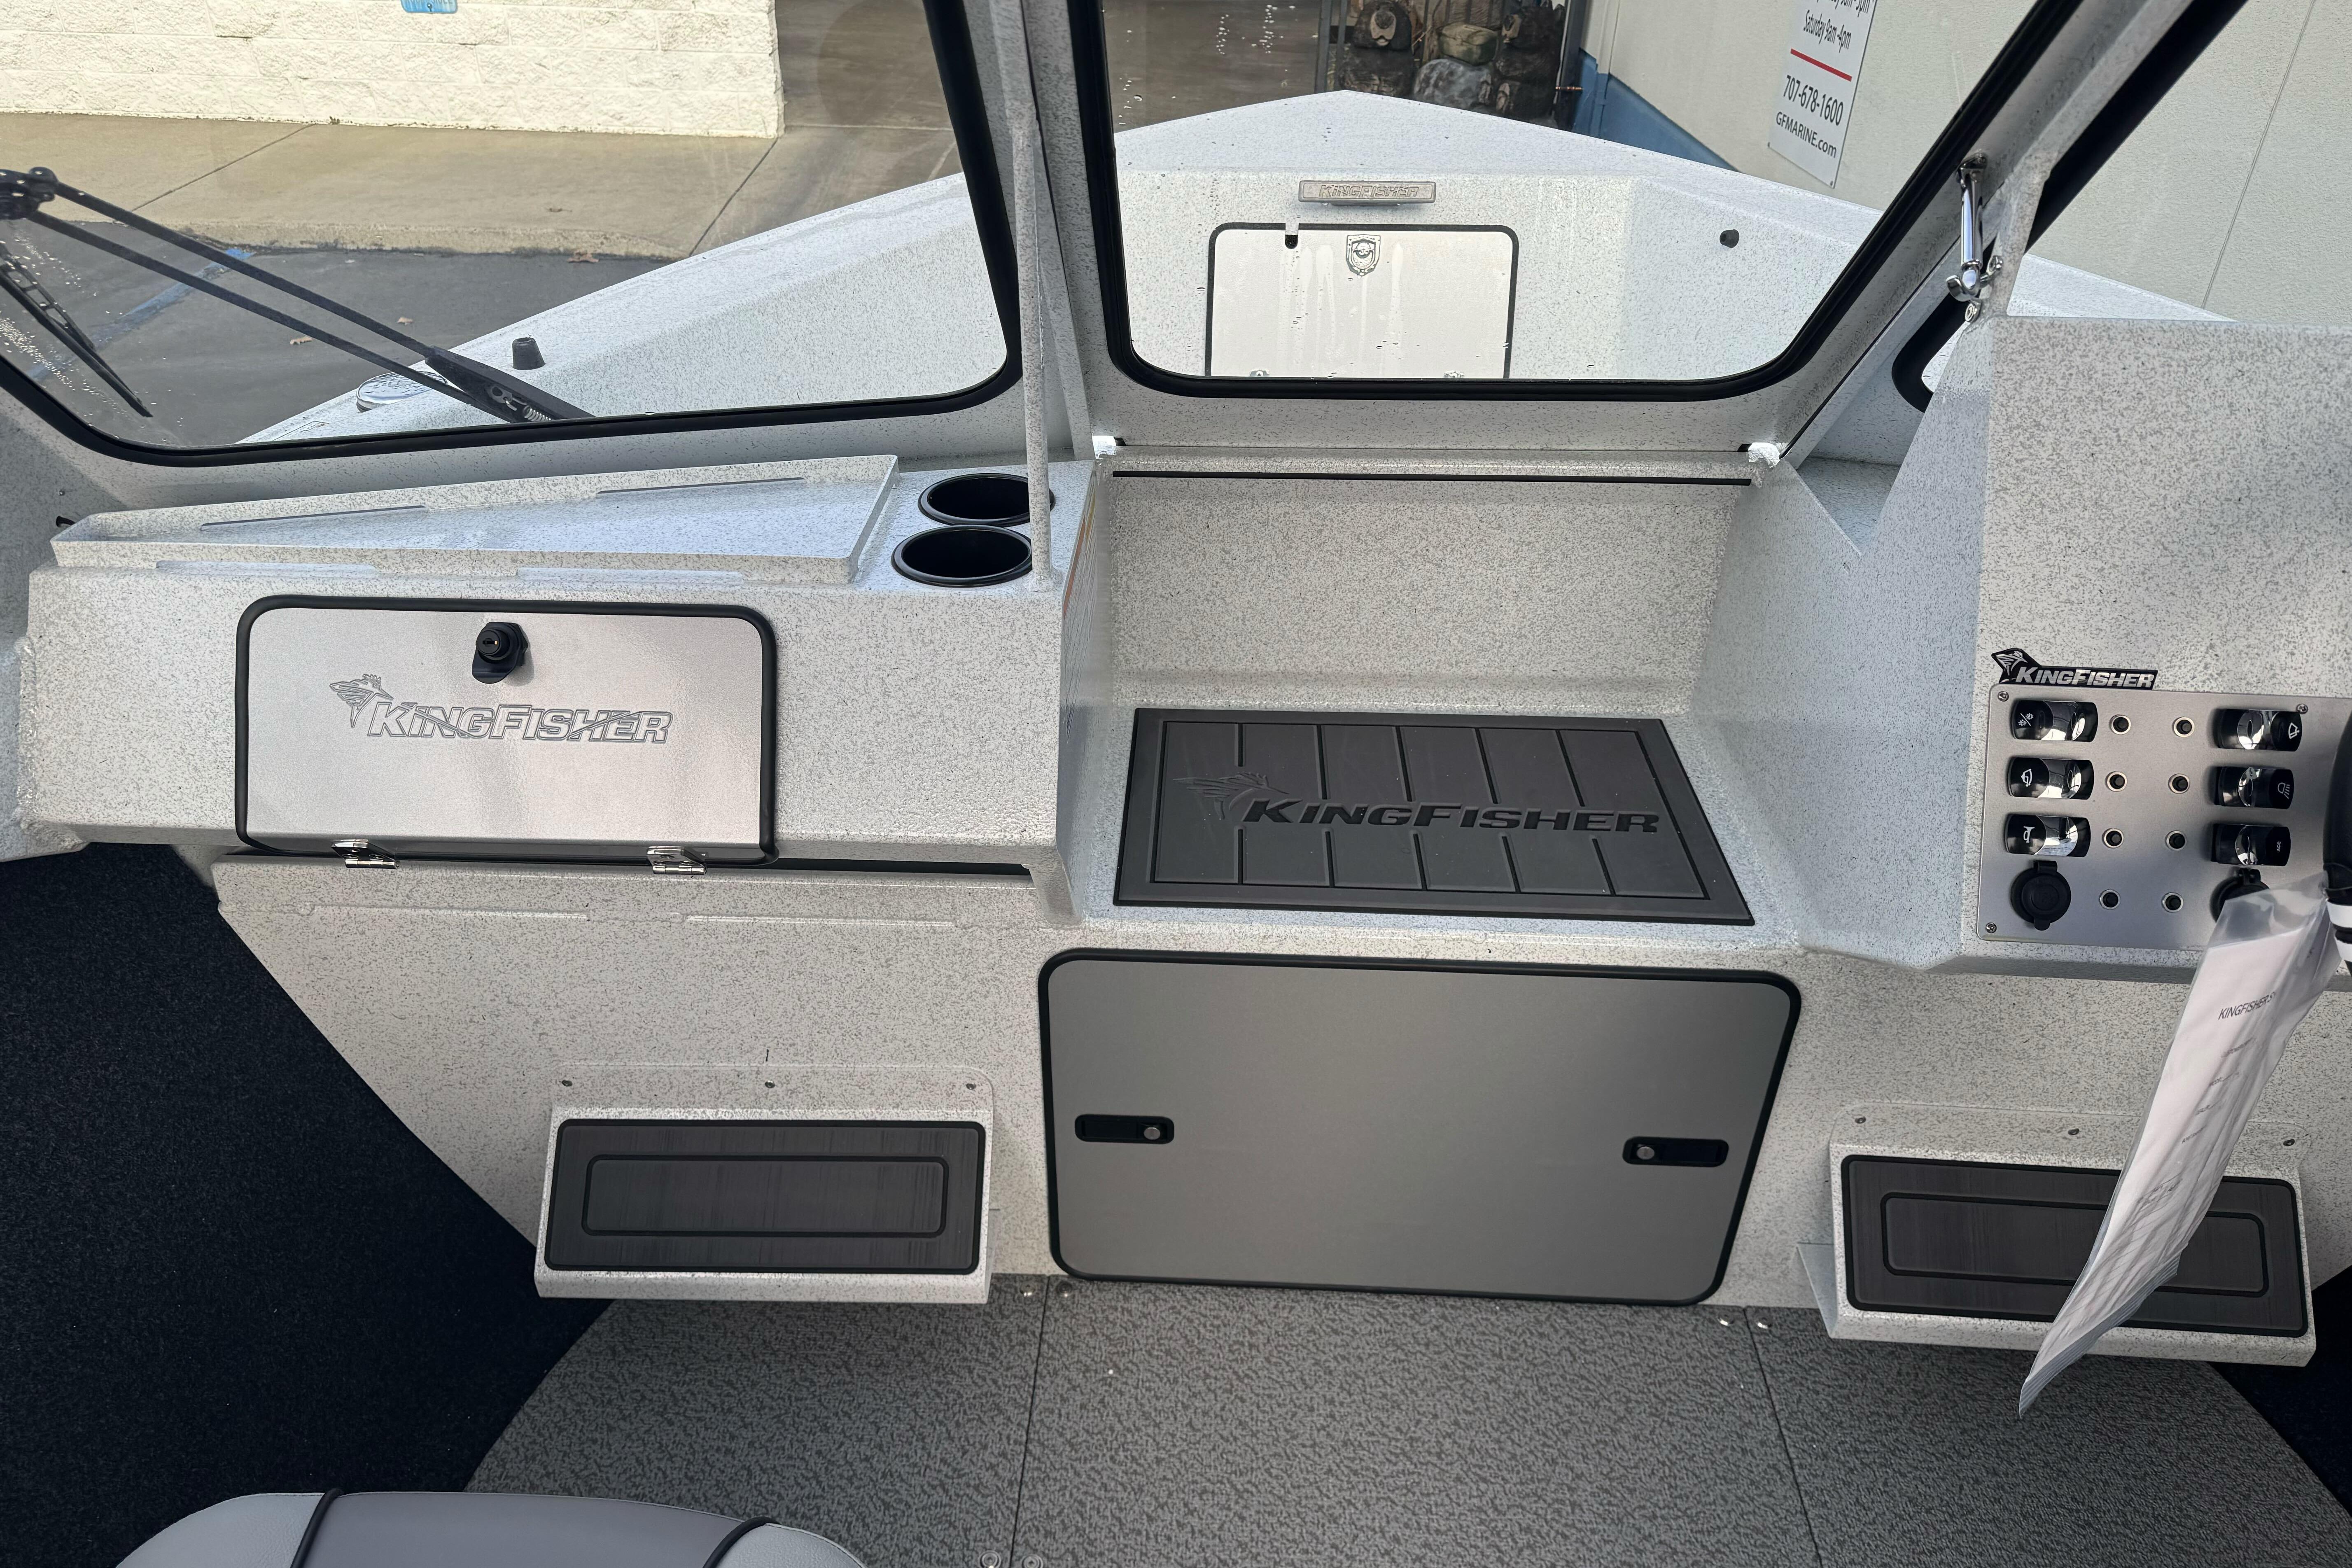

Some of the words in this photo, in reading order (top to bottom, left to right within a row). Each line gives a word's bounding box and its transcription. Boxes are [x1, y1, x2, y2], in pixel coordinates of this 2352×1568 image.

[1803, 9, 1826, 44] Saturday
[1824, 18, 1837, 44] 9am
[1783, 75, 1843, 126] 707-678-1600
[1776, 111, 1836, 158] GFMARINE.com
[1318, 184, 1419, 198] KINGFISHER
[2015, 667, 2154, 688] KINGFISHER
[367, 702, 673, 743] KINGFISHER
[1242, 798, 1658, 833] KINGFISHER
